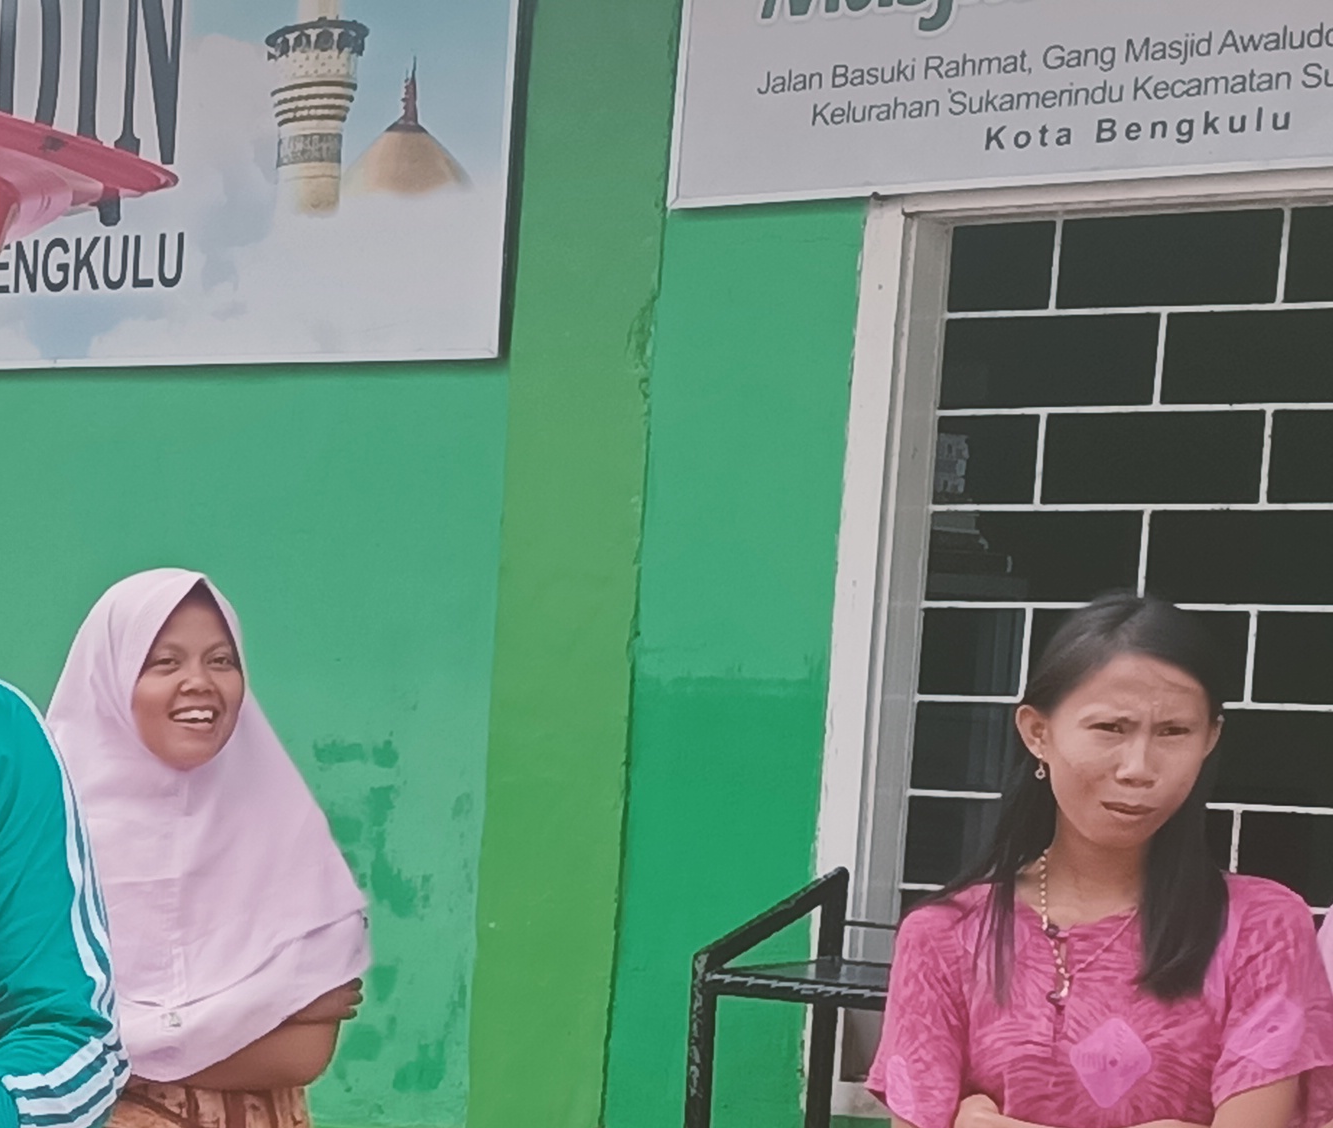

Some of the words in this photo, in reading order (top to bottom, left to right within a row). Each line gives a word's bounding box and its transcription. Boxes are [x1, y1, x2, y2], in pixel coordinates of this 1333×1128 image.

[756, 69, 823, 95] Jalan
[831, 58, 916, 89] Basuki
[924, 50, 1033, 80] Rahmat,
[1042, 44, 1117, 72] Gang
[1124, 31, 1213, 65] Masjid
[811, 96, 940, 126] Kelurahan
[948, 79, 1124, 116] Sukamerindu
[1132, 68, 1293, 101] Kecamatan
[984, 124, 1073, 151] Kota
[1095, 106, 1291, 144] Bengkulu
